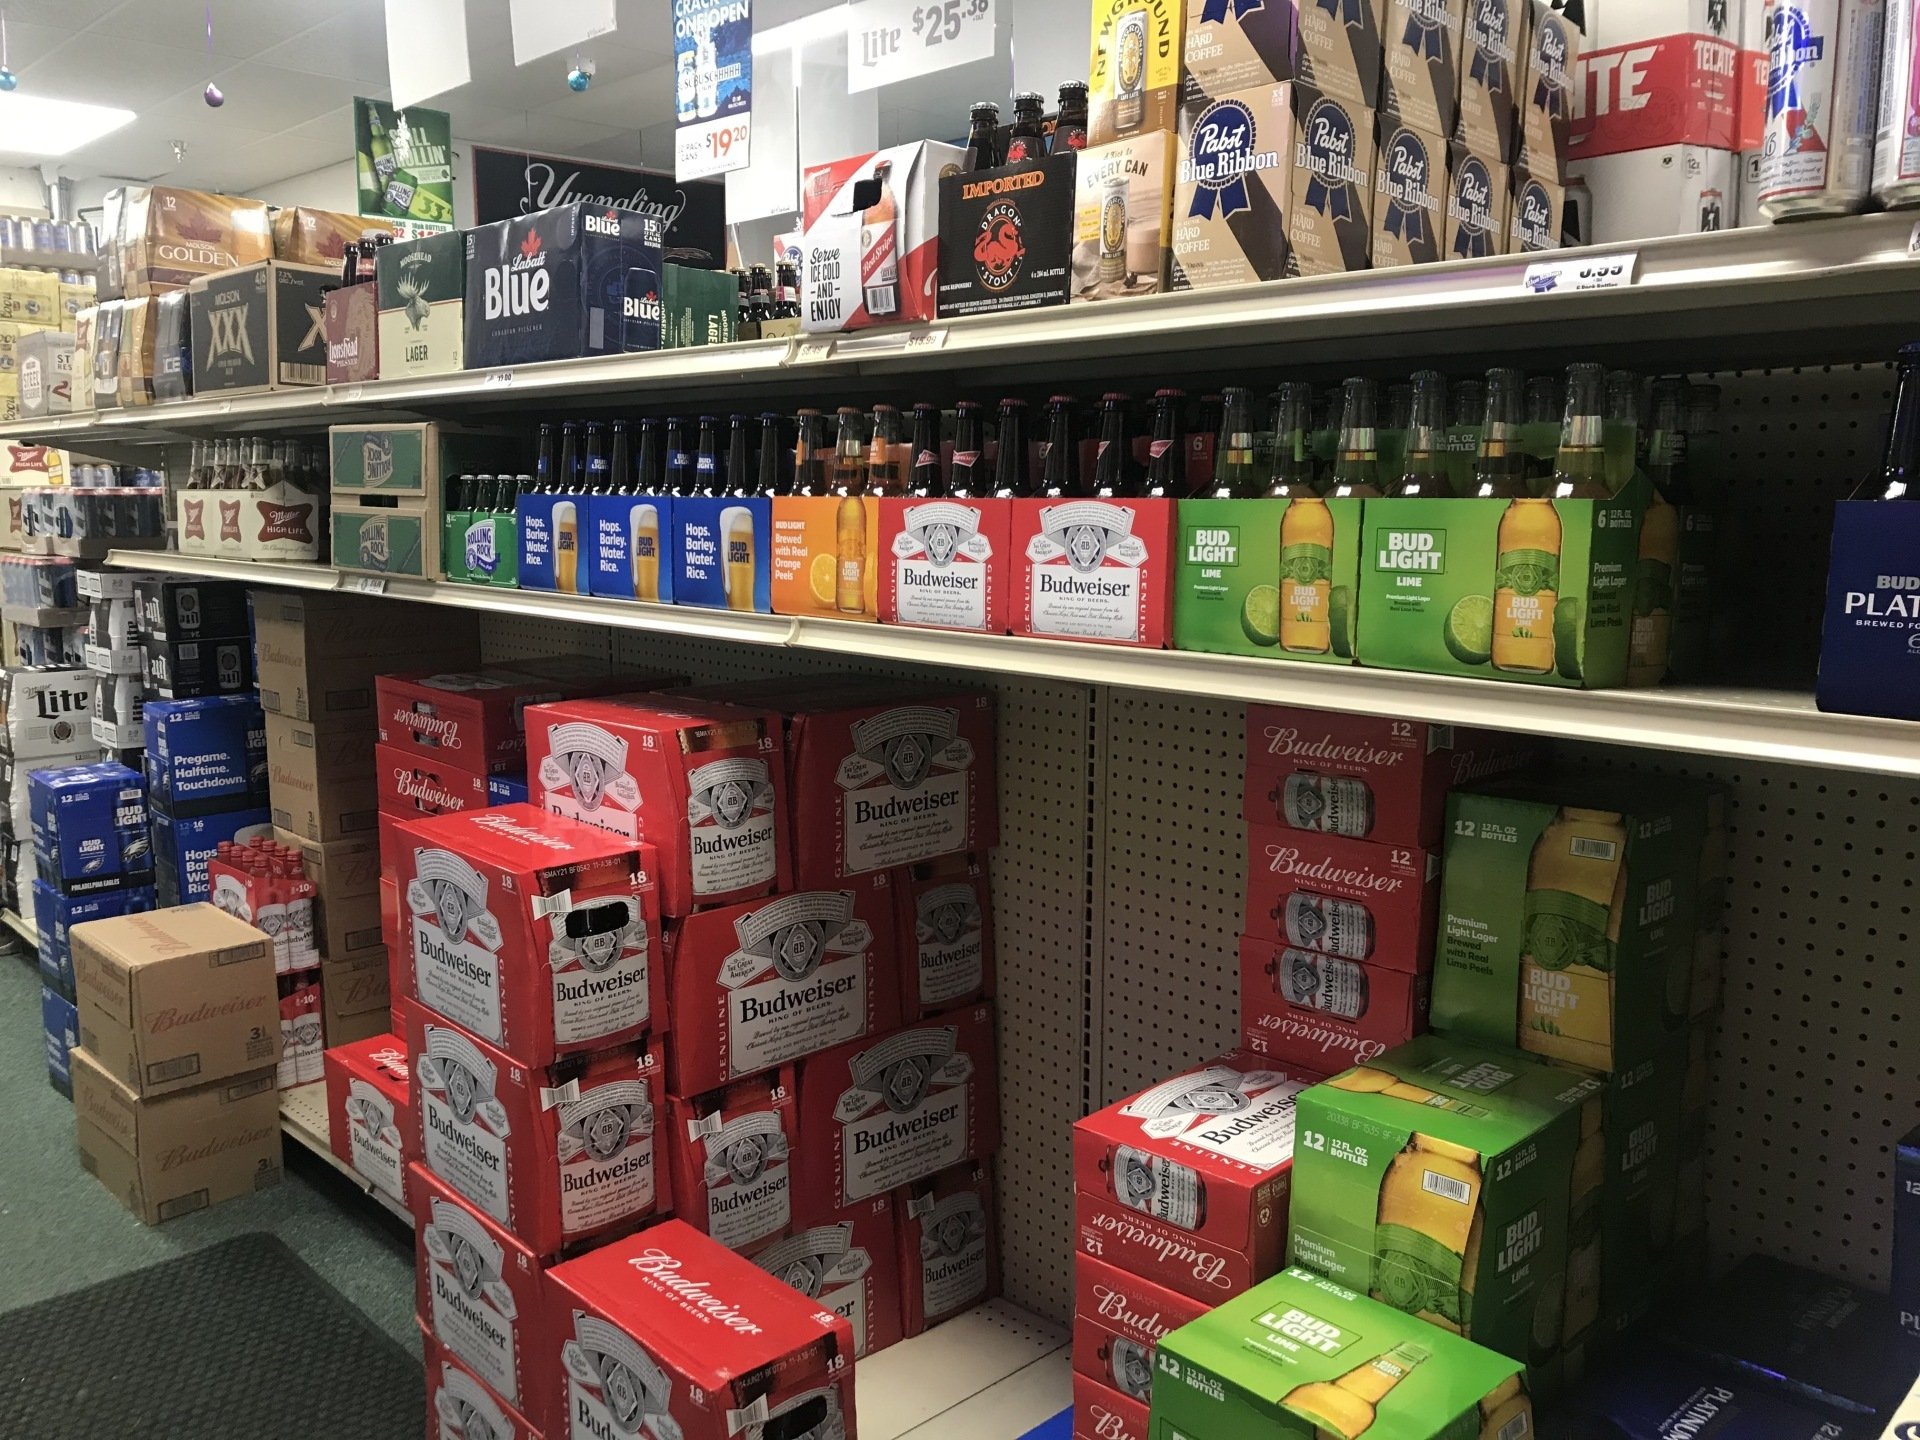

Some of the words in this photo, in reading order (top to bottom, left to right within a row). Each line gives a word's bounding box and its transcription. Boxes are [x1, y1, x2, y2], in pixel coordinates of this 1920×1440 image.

[711, 1, 749, 27] OPEN
[1303, 15, 1327, 32] HARD
[861, 25, 901, 68] Lite
[1186, 33, 1213, 48] HARD
[1303, 31, 1334, 51] COFFEE
[1542, 27, 1564, 61] Pabst
[1185, 44, 1223, 64] COFFEE
[1693, 39, 1736, 78] TECATE
[1200, 123, 1246, 155] Pabst
[1314, 117, 1350, 153] Pabst
[1180, 158, 1216, 184] Blue
[1216, 149, 1279, 178] Ribbon
[1295, 143, 1328, 178] Blue
[1328, 152, 1368, 187] Ribbon
[1394, 146, 1424, 180] Pabst
[1087, 160, 1122, 188] EVERY
[1124, 159, 1148, 177] CAN
[963, 170, 1045, 200] IMPORTED
[1376, 169, 1404, 200] Blue
[1403, 181, 1439, 212] Ribbon
[1463, 172, 1487, 204] Pabst
[981, 204, 1022, 230] DRAGON
[1449, 196, 1471, 223] Blue
[1470, 206, 1501, 235] Ribbon
[1525, 195, 1548, 225] Pabst
[585, 214, 620, 236] Blue
[1176, 225, 1200, 241] HARD
[185, 241, 216, 251] MOLSON
[1175, 237, 1210, 254] COFFEE
[159, 245, 239, 267] GOLDEN
[510, 250, 547, 272] Labatt
[810, 247, 840, 266] Serve
[810, 264, 822, 283] ICE
[823, 261, 840, 280] COLD
[983, 268, 1013, 286] STOUT
[215, 289, 241, 305] MOLSON
[485, 263, 550, 320] Blue
[623, 297, 659, 320] Blue
[810, 299, 841, 322] ENJOY
[206, 303, 255, 373] XXX
[908, 335, 937, 346] $15.99
[329, 337, 358, 364] Lionshead
[405, 345, 429, 363] LAGER
[272, 509, 301, 525] Miller
[525, 515, 545, 530] Hops.
[599, 519, 621, 534] Hops.
[1597, 509, 1607, 528] 6
[267, 525, 286, 534] HIGH
[287, 526, 305, 535] LIFE
[361, 525, 385, 542] ROLLING
[467, 528, 492, 546] ROLLING
[526, 528, 549, 542] Barley.
[599, 532, 627, 547] Barley.
[685, 522, 711, 538] Hops.
[775, 533, 802, 544] Brewed
[1195, 530, 1231, 546] BUD
[370, 541, 385, 557] ROCK
[476, 543, 492, 560] ROCK
[526, 541, 549, 553] Water.
[685, 537, 717, 553] Barley.
[1388, 532, 1434, 551] BUD
[600, 546, 626, 559] Water.
[686, 552, 716, 566] Water.
[1188, 546, 1237, 563] LIGHT
[1379, 550, 1442, 570] LIGHT
[600, 559, 619, 573] Rice.
[686, 565, 708, 580] Rice.
[775, 557, 801, 570] Orange
[775, 570, 793, 580] Peels
[903, 567, 978, 590] Budweiser
[1201, 569, 1222, 579] LIME
[1396, 576, 1422, 588] LIME
[1876, 575, 1920, 591] BUD
[1040, 573, 1131, 597] Budweiser
[1511, 596, 1539, 609] BUD
[1506, 607, 1544, 621] LIGHT
[1855, 619, 1904, 629] BREWED
[36, 689, 89, 720] Lite
[1391, 722, 1412, 736] 12
[642, 735, 654, 748] 18
[757, 737, 773, 750] 18
[1263, 725, 1404, 767] Budweiser
[174, 752, 231, 766] Pregame.
[175, 765, 230, 779] Halftime.
[176, 776, 246, 792] Touchdown.
[116, 805, 143, 817] BUD
[855, 789, 960, 824] Budweiser
[193, 820, 204, 829] 16
[693, 825, 773, 855] Budweiser
[834, 794, 842, 878] GENUINE
[1481, 830, 1518, 843] BOTTLES
[1391, 850, 1411, 866] 12
[629, 870, 648, 886] 18
[1265, 844, 1403, 893] Budweiser
[71, 881, 102, 892] PHILADELPHIA
[103, 878, 120, 888] EAGLES
[501, 874, 513, 889] 18
[1639, 896, 1675, 926] LIGHT
[1447, 914, 1488, 930] Premium
[1447, 925, 1470, 941] Light
[1471, 929, 1498, 945] Lager
[418, 930, 492, 988] Budweiser
[1469, 950, 1489, 964] Real
[1469, 961, 1493, 976] Peels
[556, 966, 646, 1003] Budweiser
[1530, 968, 1571, 992] BUD
[740, 974, 857, 1024] Budweiser
[1523, 982, 1579, 1010] LIGHT
[718, 993, 726, 1082] GENUINE
[1251, 1036, 1268, 1053] 12
[1257, 1013, 1387, 1066] Budweiser
[636, 1053, 655, 1070] 18
[769, 1086, 786, 1101] 18
[853, 1102, 960, 1155] Budweiser
[1303, 1130, 1325, 1152] 12
[1331, 1138, 1342, 1149] 12
[1342, 1142, 1354, 1154] FL.
[1354, 1146, 1369, 1158] OZ.
[1169, 1138, 1264, 1176] GENUINE
[1330, 1149, 1369, 1168] BOTTLES
[563, 1152, 651, 1193] Budweiser
[833, 1129, 841, 1210] GENUINE
[1496, 1159, 1512, 1182] 12
[711, 1175, 788, 1216] Budweiser
[1506, 1209, 1538, 1246] BUD
[1085, 1237, 1104, 1255] 12
[1091, 1214, 1232, 1290] Budweiser
[1293, 1233, 1336, 1260] Premium
[1498, 1229, 1544, 1273] LIGHT
[1293, 1247, 1319, 1267] Light
[1319, 1254, 1347, 1275] Lager
[1511, 1264, 1531, 1285] LIME
[628, 1247, 762, 1337] Budweiser
[642, 1276, 666, 1294] KING
[667, 1291, 678, 1302] OF
[1258, 1313, 1341, 1353] LIGHT
[1281, 1308, 1342, 1339] BUD
[1266, 1333, 1301, 1353] LIME
[826, 1353, 846, 1372] 18
[1158, 1353, 1181, 1379] 12
[1186, 1366, 1199, 1381] 12
[1186, 1377, 1225, 1402] BOTTLES
